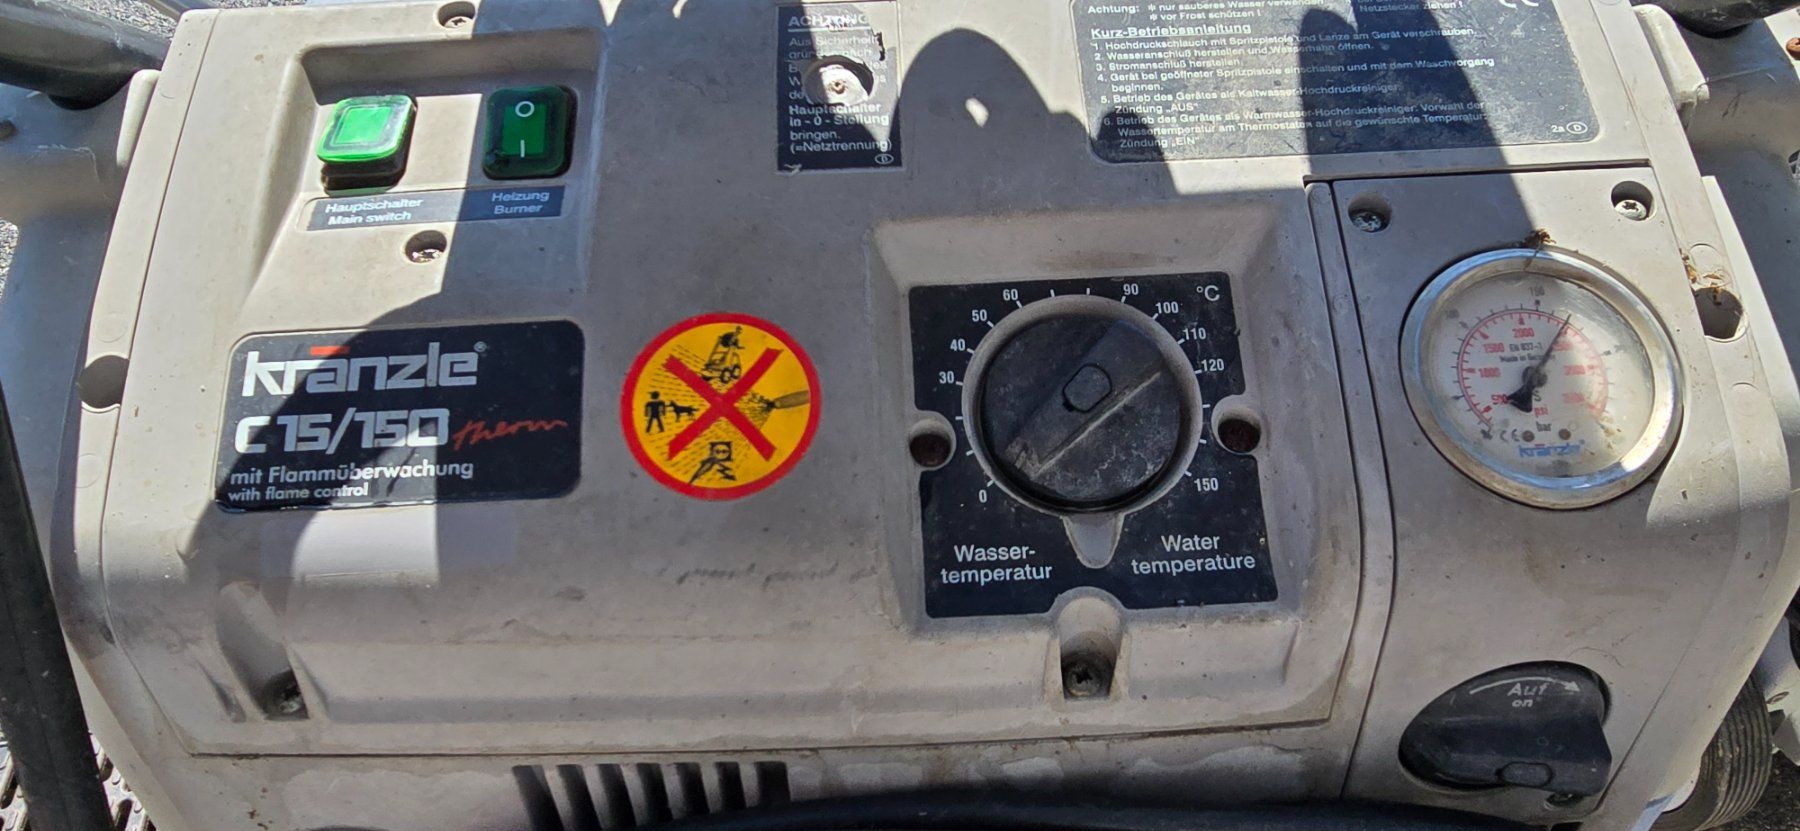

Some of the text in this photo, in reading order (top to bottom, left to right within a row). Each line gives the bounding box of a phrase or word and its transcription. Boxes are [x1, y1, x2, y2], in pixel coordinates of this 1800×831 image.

[1088, 4, 1140, 14] Achtung:
[1179, 1, 1225, 10] sauberes
[1228, 0, 1265, 8] Wasser
[1160, 13, 1177, 21] vor
[1180, 11, 1206, 20] Frost
[1209, 9, 1254, 19] schützen
[1091, 24, 1251, 39] Kurz-Betriebsanleitung
[1105, 39, 1208, 50] Hochdruckschlauch
[1211, 37, 1227, 46] mit
[1229, 35, 1294, 46] Spritzpistole
[1371, 30, 1401, 39] Gerät
[1403, 27, 1477, 37] verschrauben.
[1107, 49, 1191, 60] Wasseranschluß
[1194, 47, 1245, 57] herstellen
[1248, 46, 1267, 54] und
[1109, 60, 1187, 71] Stromanschluß
[1110, 72, 1139, 81] Gerät
[1142, 71, 1158, 80] bei
[1217, 67, 1281, 78] Spritzpistole
[1347, 62, 1367, 71] und
[1370, 61, 1387, 70] mit
[1389, 61, 1413, 69] dem
[1416, 57, 1494, 68] Waschvorgang
[1112, 84, 1163, 93] beginnen.
[1113, 94, 1150, 103] Betrieb
[1154, 92, 1173, 101] des
[1176, 91, 1217, 100] Gerätes
[789, 103, 881, 115] Hauptschalter
[1115, 105, 1162, 114] Zündung
[789, 116, 801, 127] in
[834, 113, 890, 126] Stellung
[1117, 116, 1154, 125] Betrieb
[1158, 115, 1176, 123] des
[1118, 125, 1215, 137] Wassertemperatur
[1121, 138, 1168, 148] Zündung
[491, 191, 550, 204] Heizung
[325, 198, 423, 213] Hauptschalter
[494, 203, 543, 215] Burner
[328, 210, 411, 226] Main switch
[1002, 288, 1018, 301] 60
[1123, 283, 1139, 296] 90
[1156, 301, 1179, 315] 100
[972, 310, 987, 323] 50
[1183, 328, 1206, 342] 110
[950, 339, 966, 352] 40
[1201, 359, 1224, 372] 120
[939, 371, 955, 385] 30
[235, 415, 272, 454] C
[276, 407, 450, 455] 15/150
[1536, 421, 1551, 432] bar
[230, 459, 474, 485] mit Flammüberwachung
[1194, 478, 1219, 492] 150
[228, 483, 369, 501] with flame control
[978, 490, 987, 503] 0
[1161, 534, 1220, 552] Water
[954, 545, 1036, 563] Wasser-
[1131, 554, 1256, 577] temperature
[941, 565, 1052, 586] temperatur
[1512, 698, 1534, 708] on
